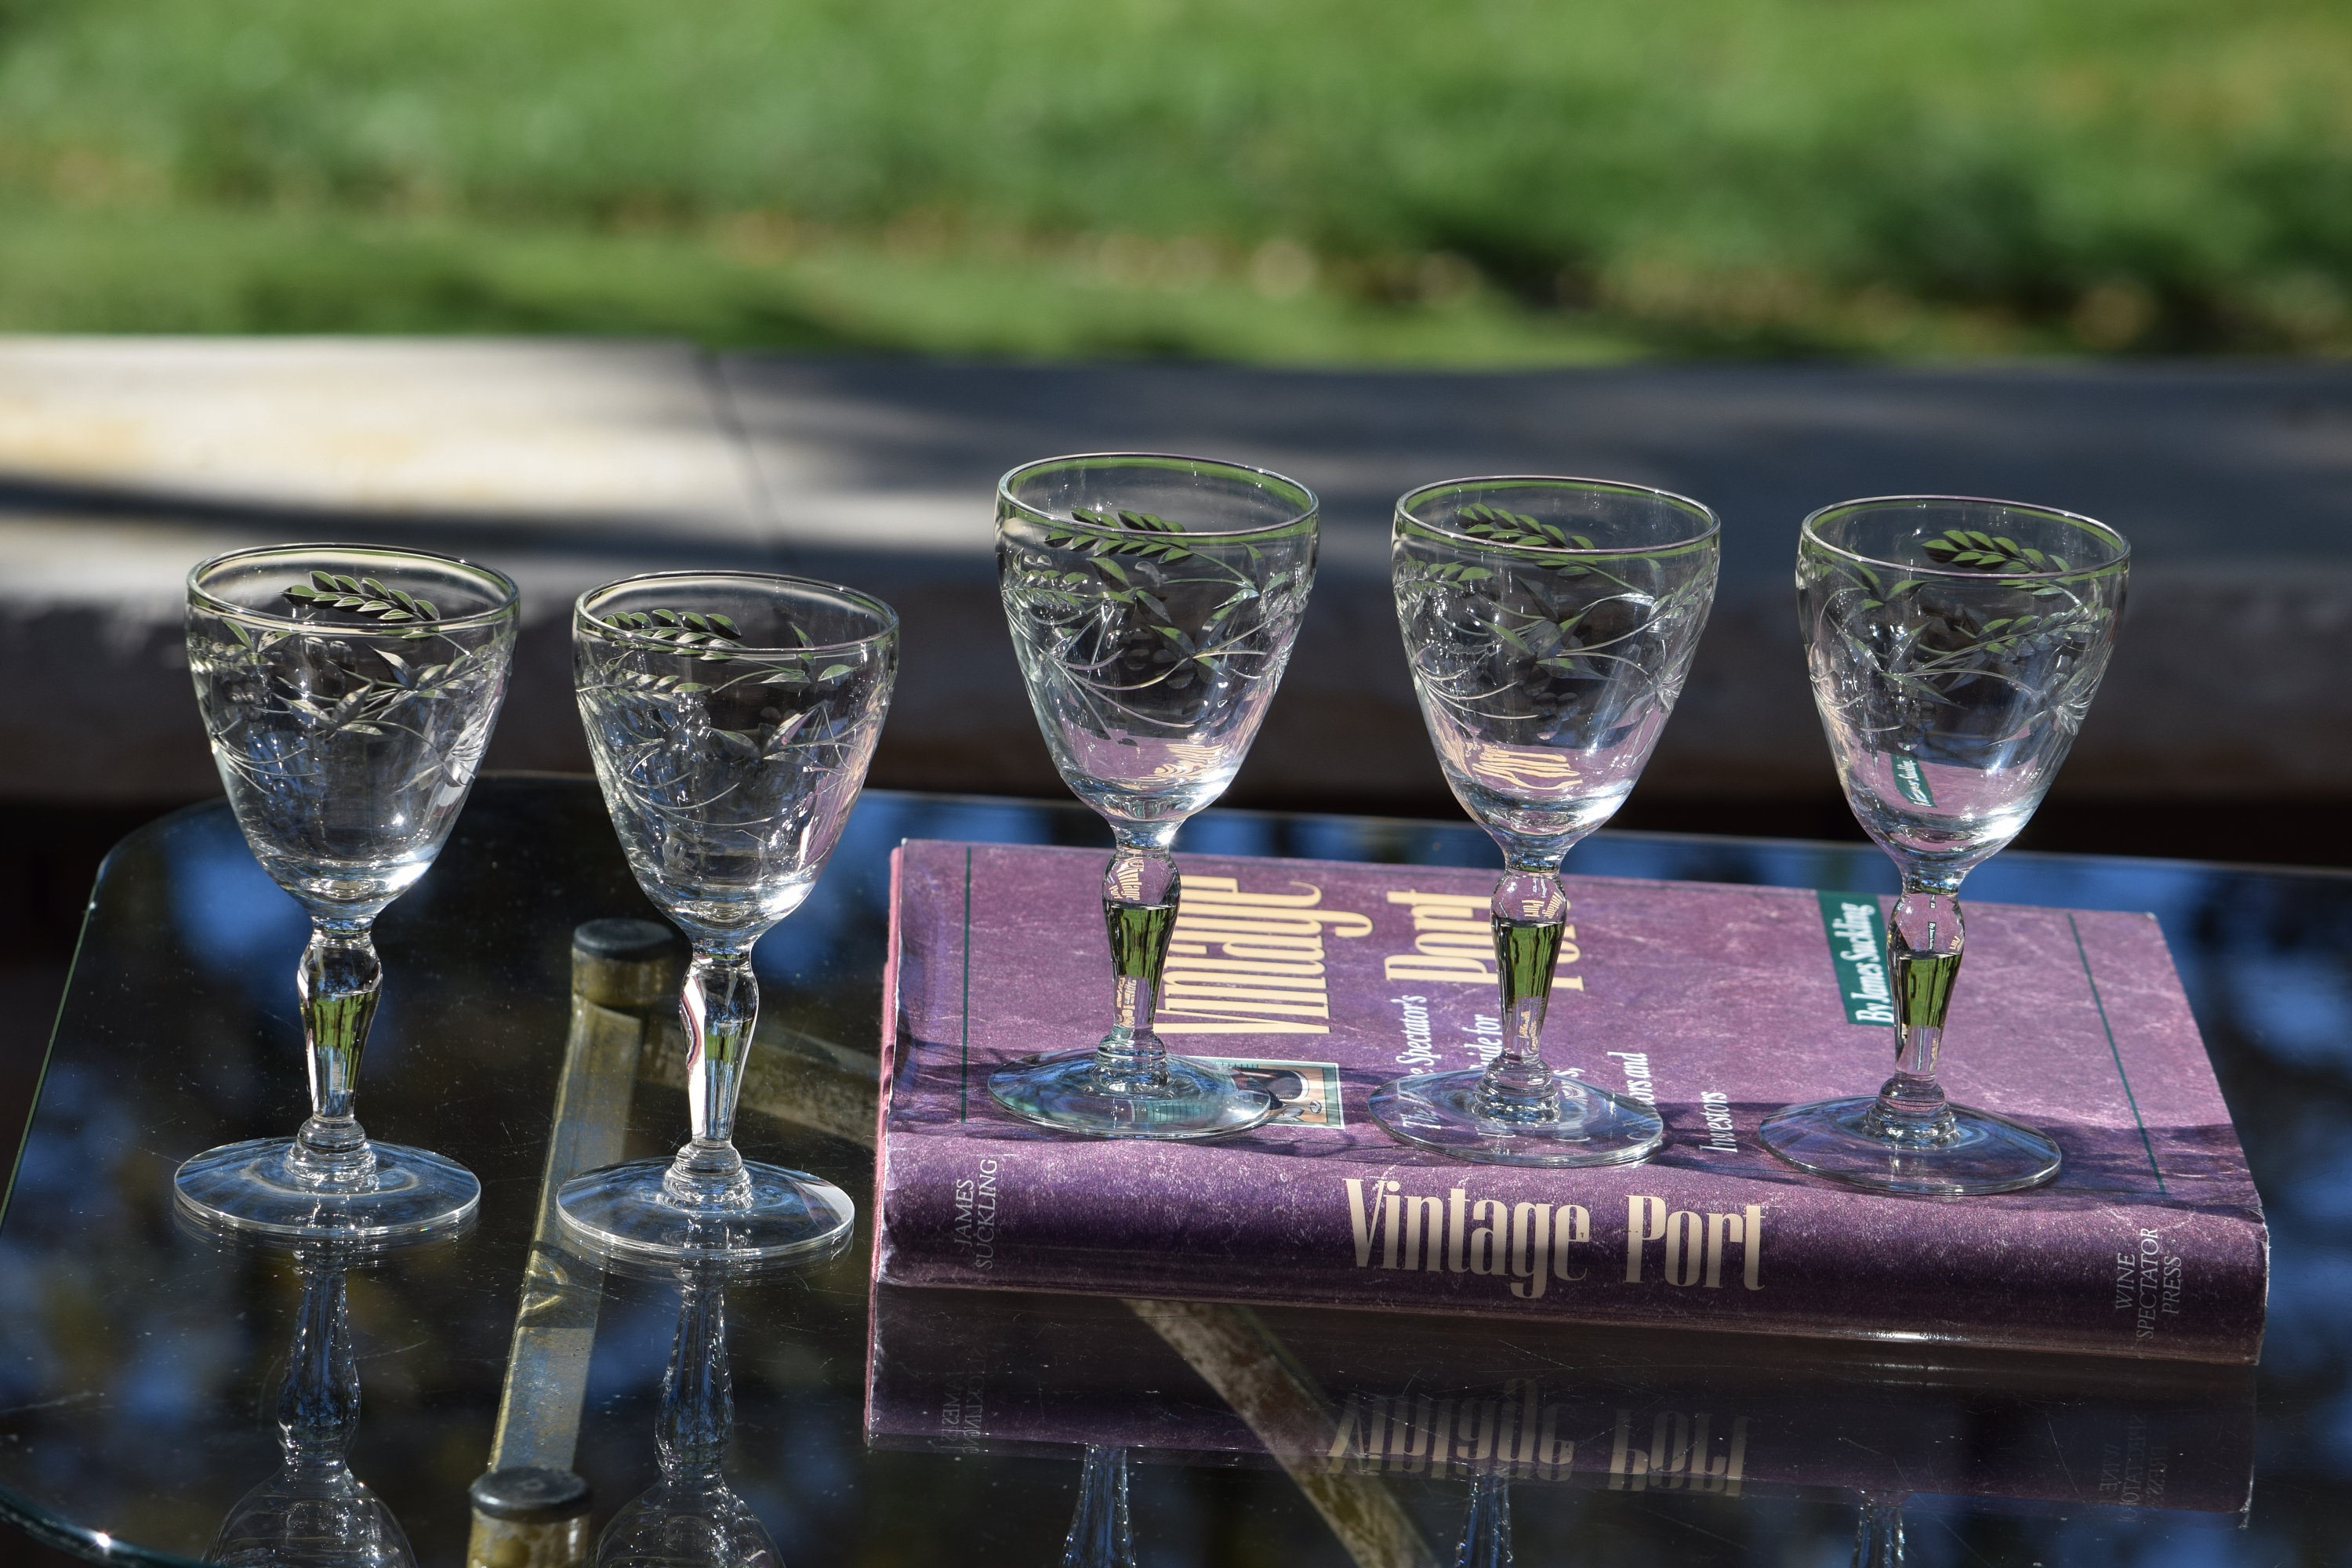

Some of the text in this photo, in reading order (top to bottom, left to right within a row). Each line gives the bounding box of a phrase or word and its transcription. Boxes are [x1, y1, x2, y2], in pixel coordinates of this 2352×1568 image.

[1155, 875, 1374, 1034] Vintage
[1385, 889, 1584, 991] Port
[1832, 902, 1894, 1023] By James Suckling
[1391, 995, 1441, 1066] Spectator's
[1461, 1014, 1502, 1069] uide for
[1607, 1051, 1652, 1079] and
[1699, 1091, 1738, 1152] Investors
[954, 1179, 974, 1247] JAMES
[976, 1159, 997, 1269] SUCKLING
[1344, 1178, 1766, 1299] Vintage Port
[2117, 1253, 2135, 1310] WINE
[2136, 1228, 2158, 1339] SPECTATOR
[2161, 1256, 2182, 1315] PRESS
